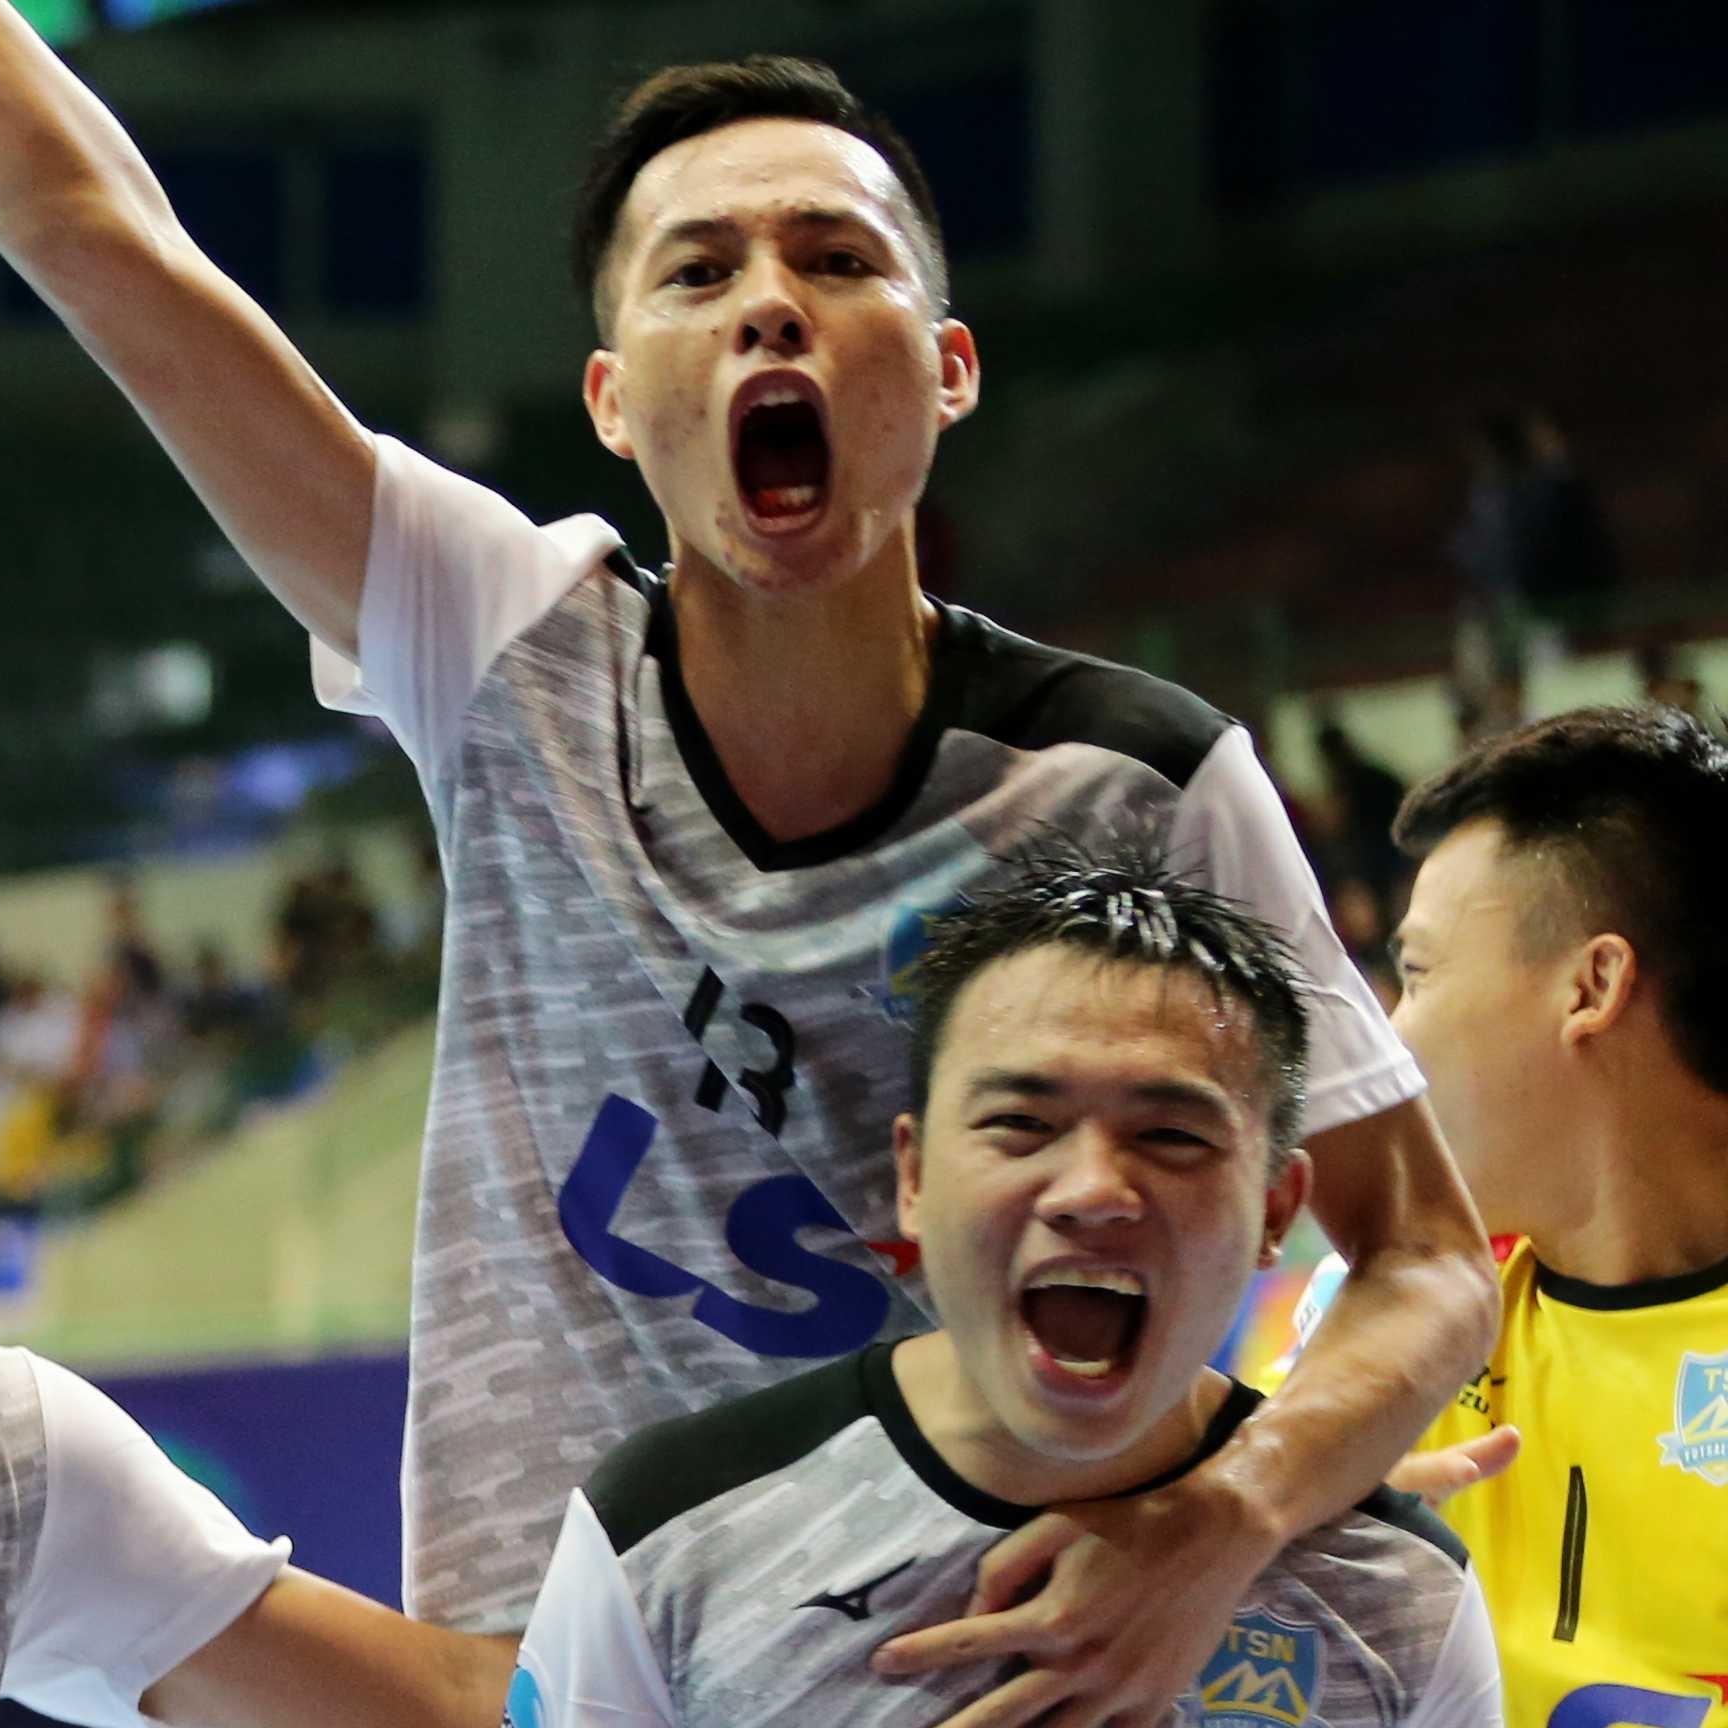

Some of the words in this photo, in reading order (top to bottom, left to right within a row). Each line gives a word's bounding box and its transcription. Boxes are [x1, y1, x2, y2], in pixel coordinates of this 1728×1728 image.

[558, 1092, 890, 1359] LS
[1227, 1624, 1296, 1662] TSN
[1552, 1464, 1588, 1643] 1
